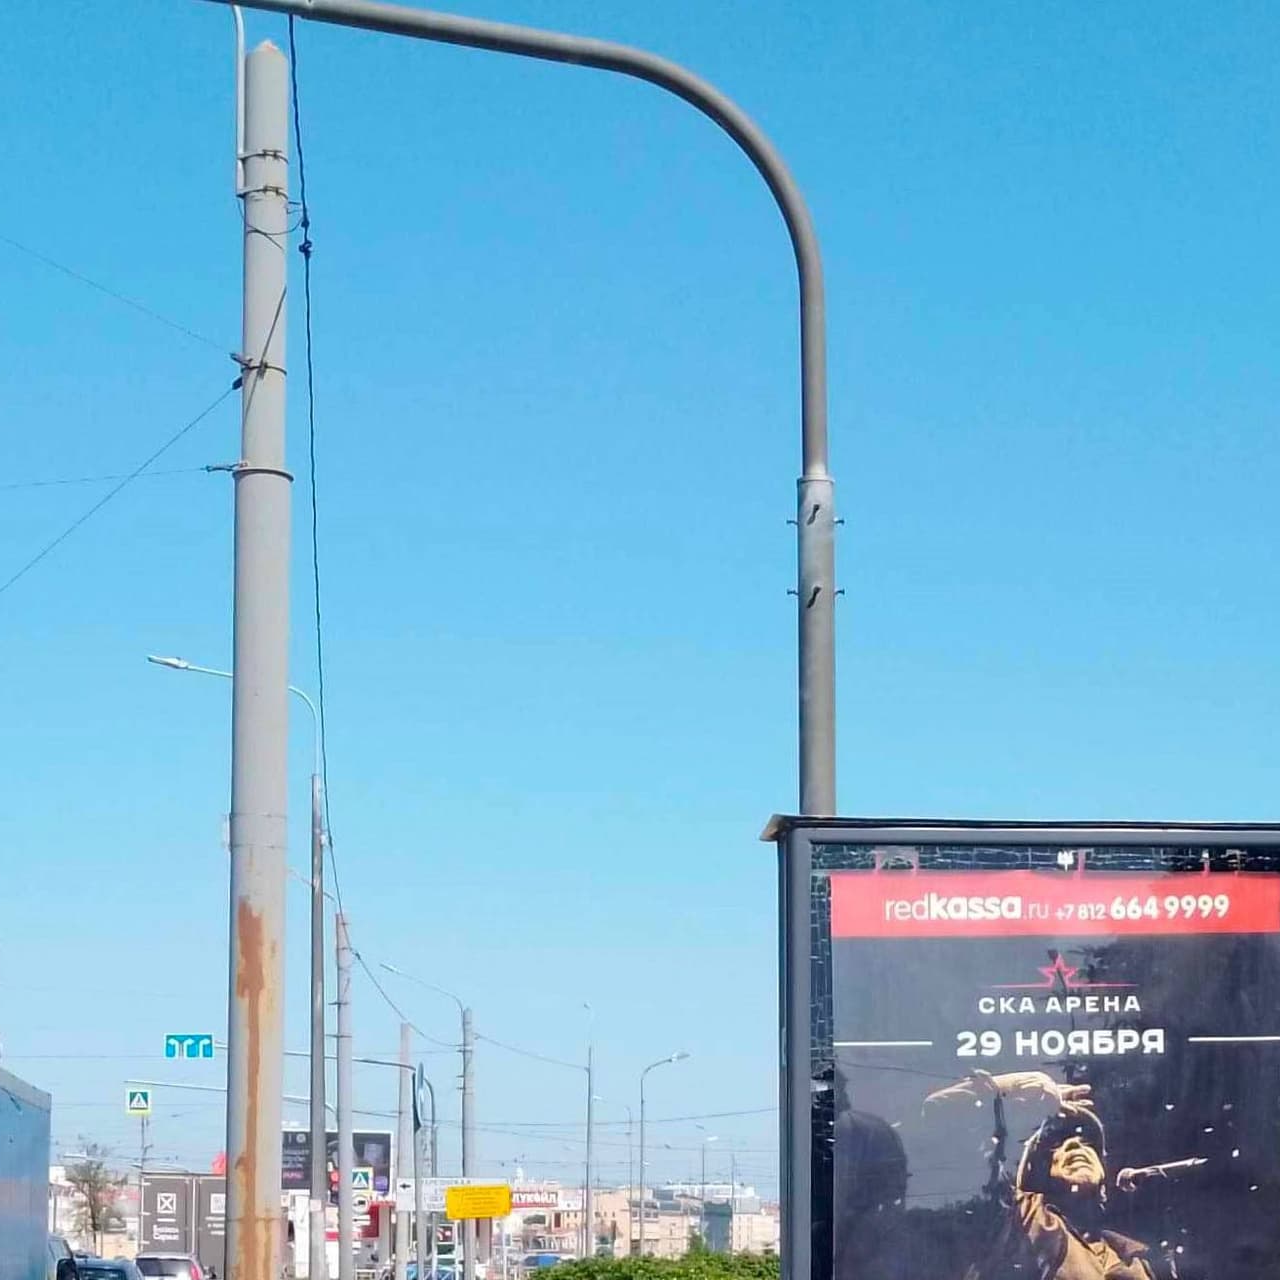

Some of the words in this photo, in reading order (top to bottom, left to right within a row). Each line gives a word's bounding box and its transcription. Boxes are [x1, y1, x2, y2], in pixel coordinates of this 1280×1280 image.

[885, 892, 1049, 921] redkassa.ru
[1056, 904, 1074, 920] +7
[1078, 903, 1107, 920] 812
[1110, 895, 1159, 920] 664
[1164, 893, 1230, 920] 9999
[978, 996, 1035, 1014] СКА
[1045, 995, 1141, 1013] АРЕНА
[956, 1030, 1002, 1056] 29
[1015, 1028, 1165, 1056] НОЯБРЯ
